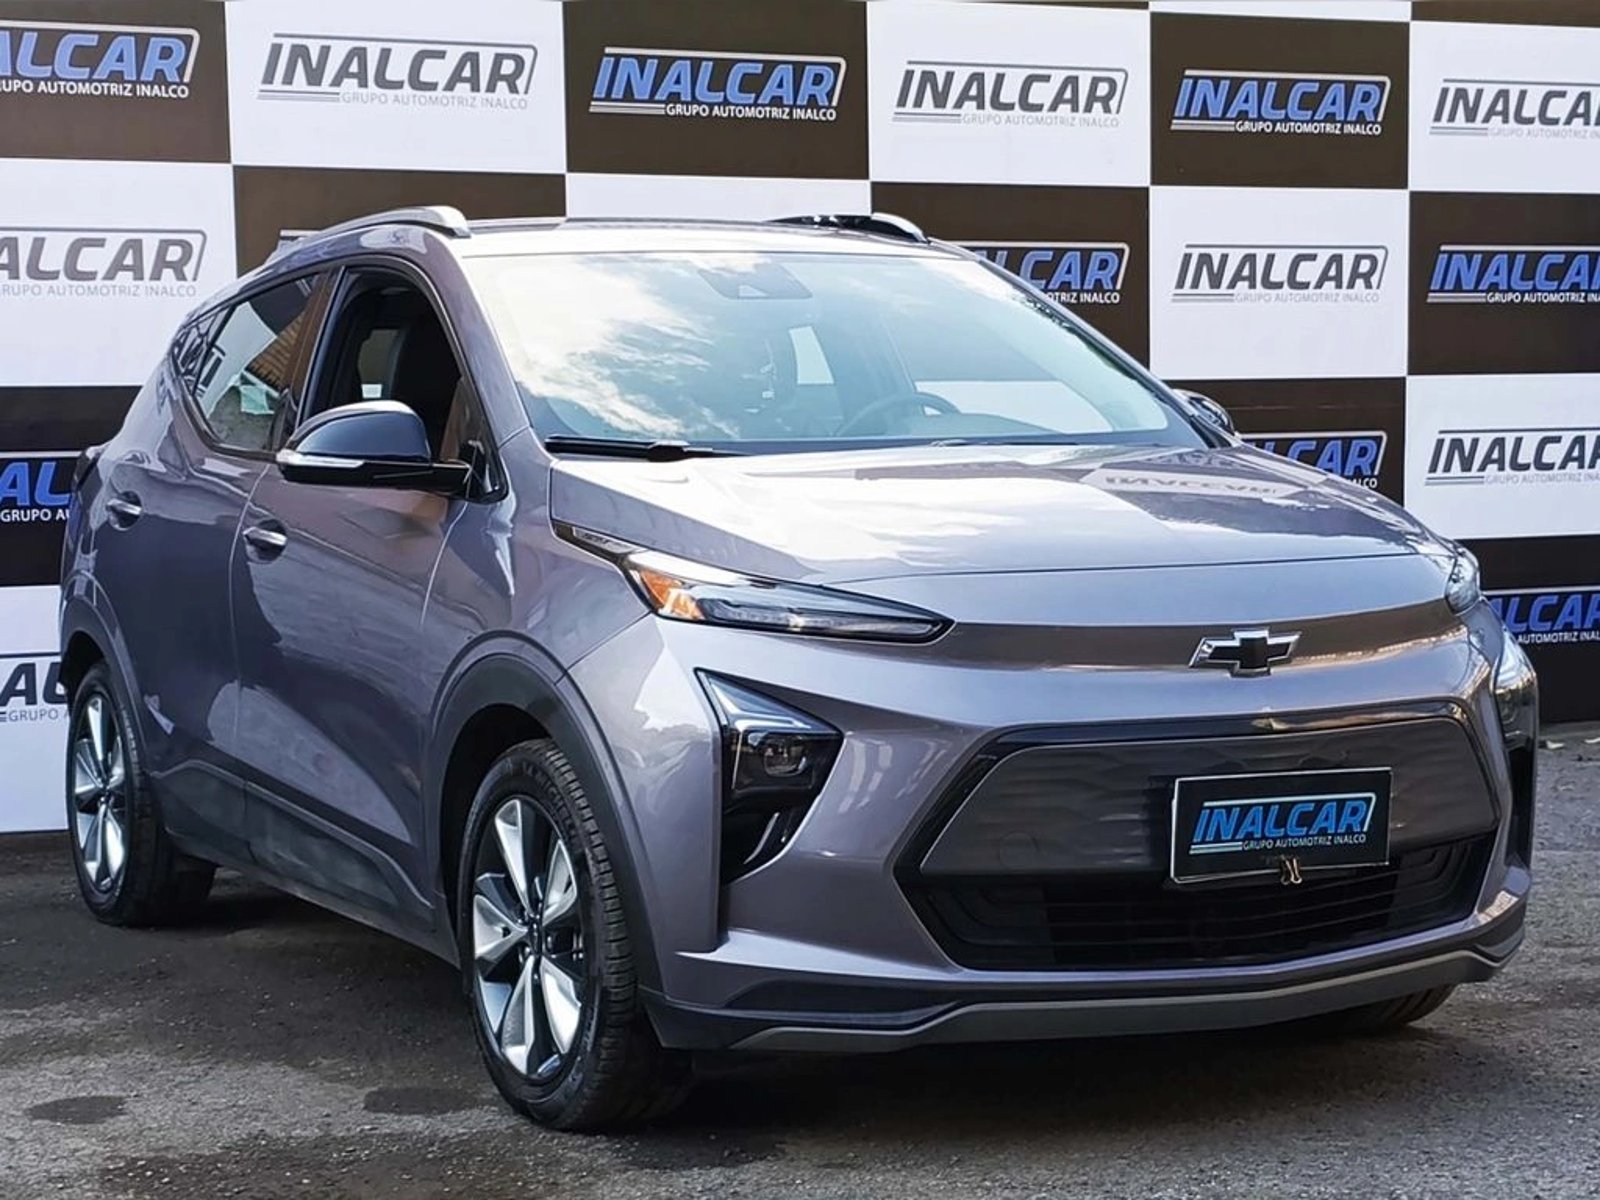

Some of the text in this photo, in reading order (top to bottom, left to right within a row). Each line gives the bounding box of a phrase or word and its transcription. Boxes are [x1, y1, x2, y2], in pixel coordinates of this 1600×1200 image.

[261, 42, 526, 95] INALCAR
[37, 81, 133, 97] AUTOMOTRIZ
[136, 85, 189, 98] INALCO
[593, 56, 836, 107] INALCAR
[896, 68, 1118, 114] INALCAR
[341, 91, 528, 110] GRUPO AUTOMOTRIZ INALCO
[1174, 78, 1381, 122] INALCAR
[1433, 86, 1600, 127] INALCA
[666, 103, 837, 121] GRUPO AUTOMOTRIZ INALCO
[961, 113, 1120, 129] GRUPO AUTOMOTRIZ INALCO
[1235, 120, 1382, 136] GRUPO AUTOMOTRIZ INALCO
[1174, 252, 1379, 291] INALCAR
[47, 284, 140, 298] AUTOMOTRIZ
[145, 285, 197, 298] INALCO
[1080, 292, 1121, 304] INALCO
[1234, 291, 1380, 304] GRUPO AUTOMOTRIZ INALCO
[1486, 291, 1521, 303] GRUPO
[1523, 291, 1586, 303] AUTOMOTRIZ
[1484, 474, 1520, 485] GRUPO
[1521, 472, 1582, 484] AUTOMOTRIZ
[0, 508, 52, 522] GRUPO
[1517, 631, 1579, 644] AUTOMOTRIZ
[8, 708, 59, 722] GRUPO
[1192, 799, 1367, 842] INALCAR
[1242, 833, 1366, 852] GRUPO AUTOMOTRIZ INALCO
